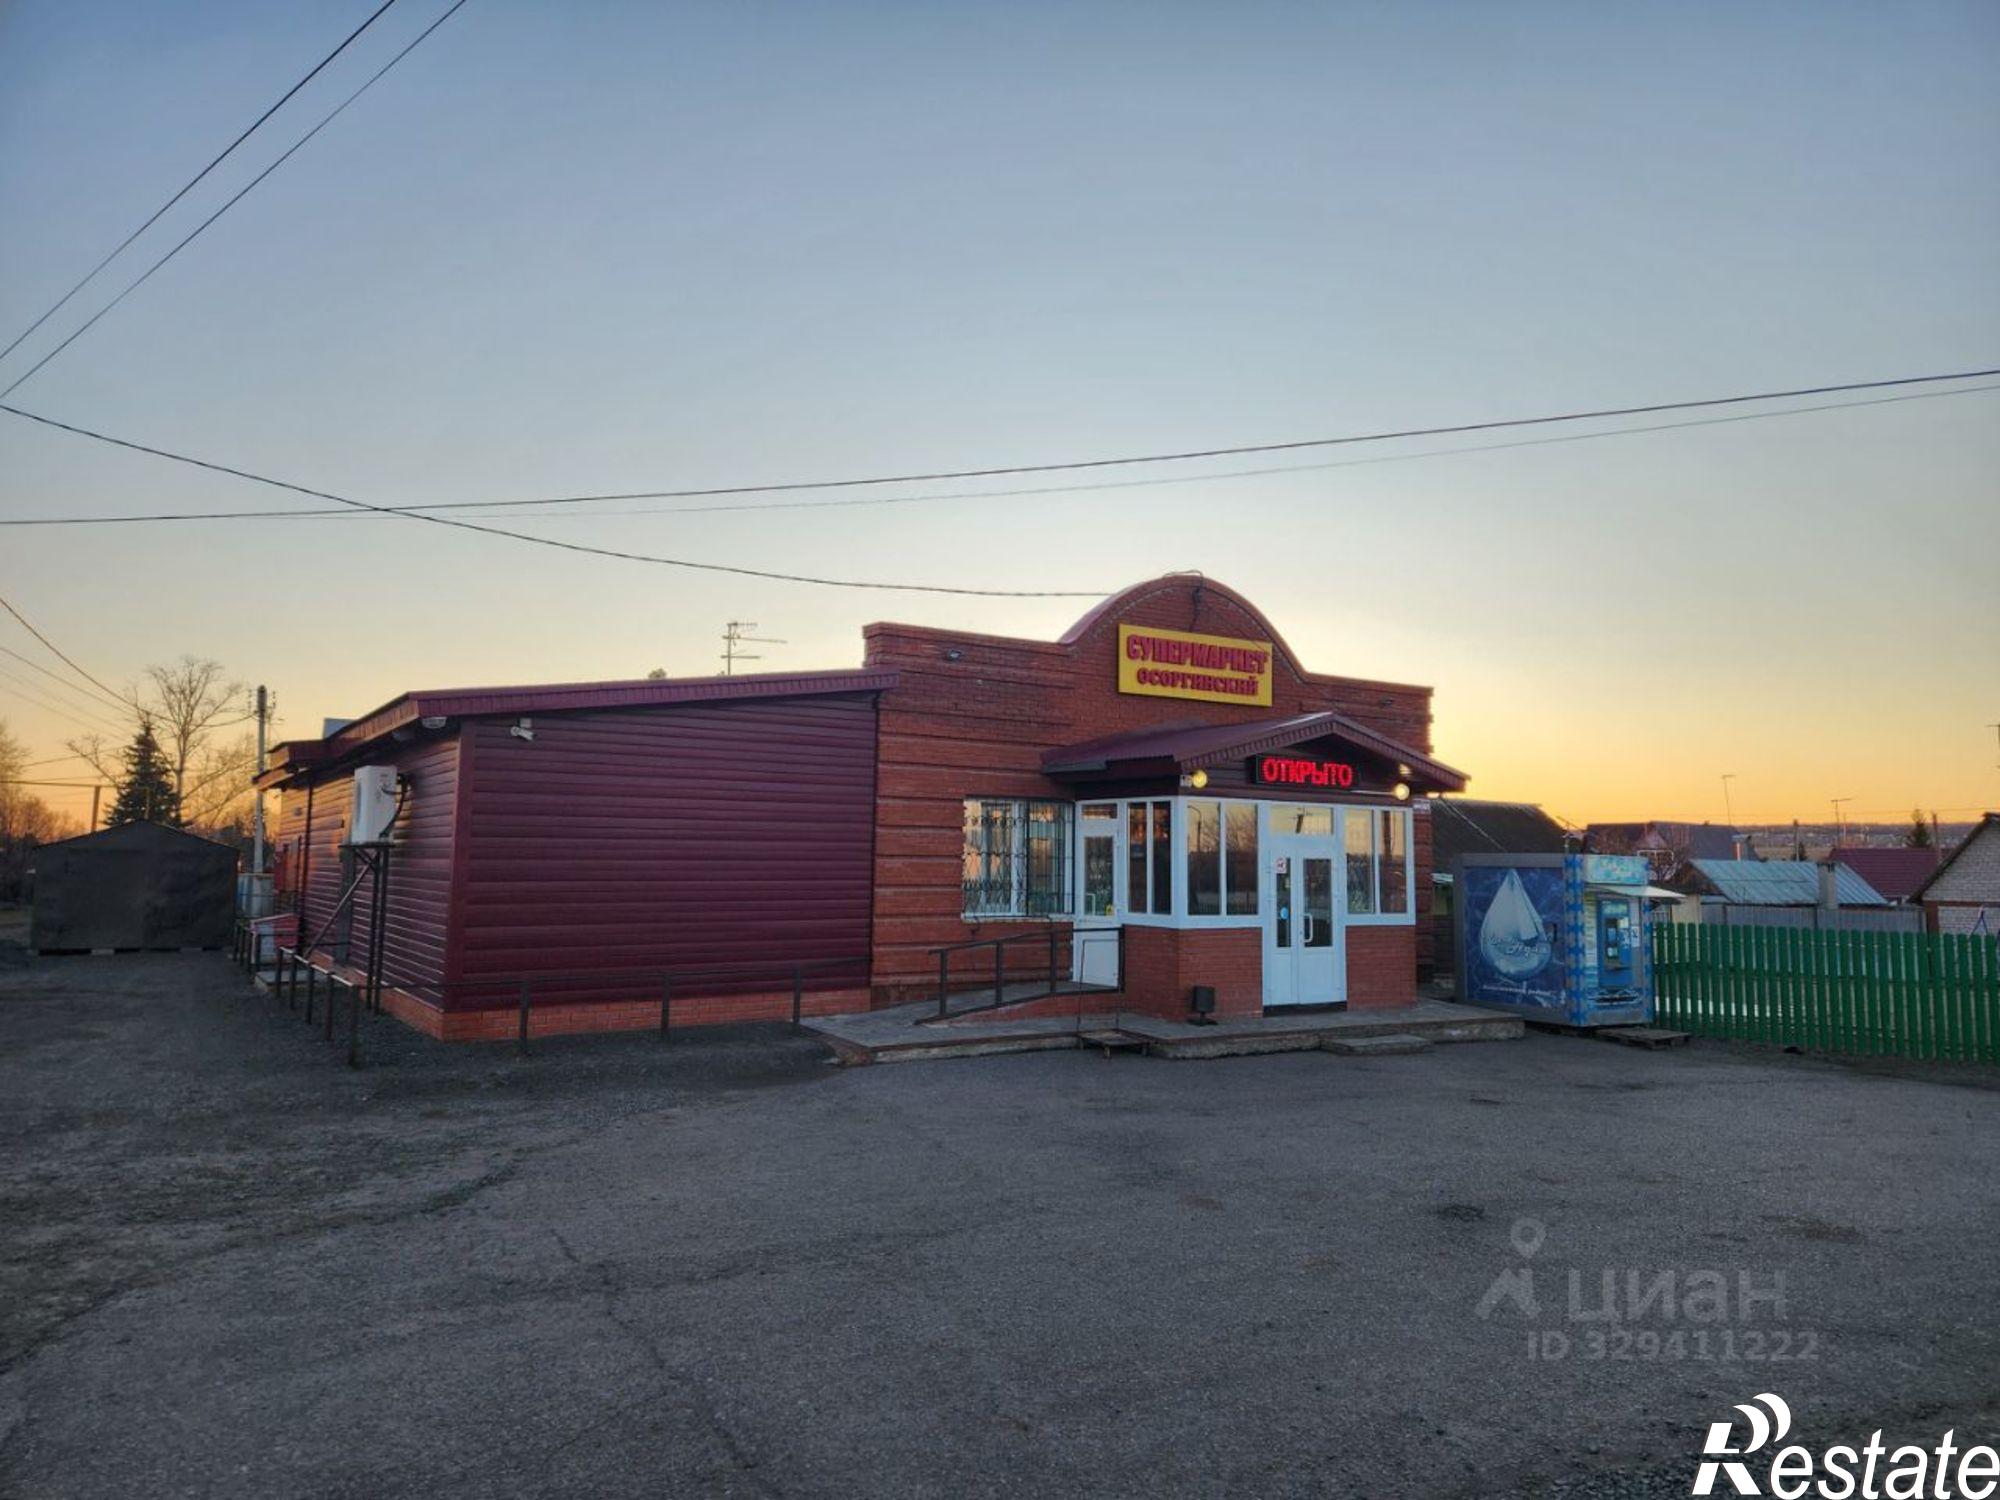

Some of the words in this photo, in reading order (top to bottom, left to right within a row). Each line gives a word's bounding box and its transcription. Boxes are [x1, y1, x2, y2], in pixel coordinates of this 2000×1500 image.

[1126, 634, 1268, 674] СУПЕРМАРКЕТ
[1137, 667, 1258, 696] ОСОРГИНСКИЙ
[1263, 758, 1353, 787] ОТКРЫТО
